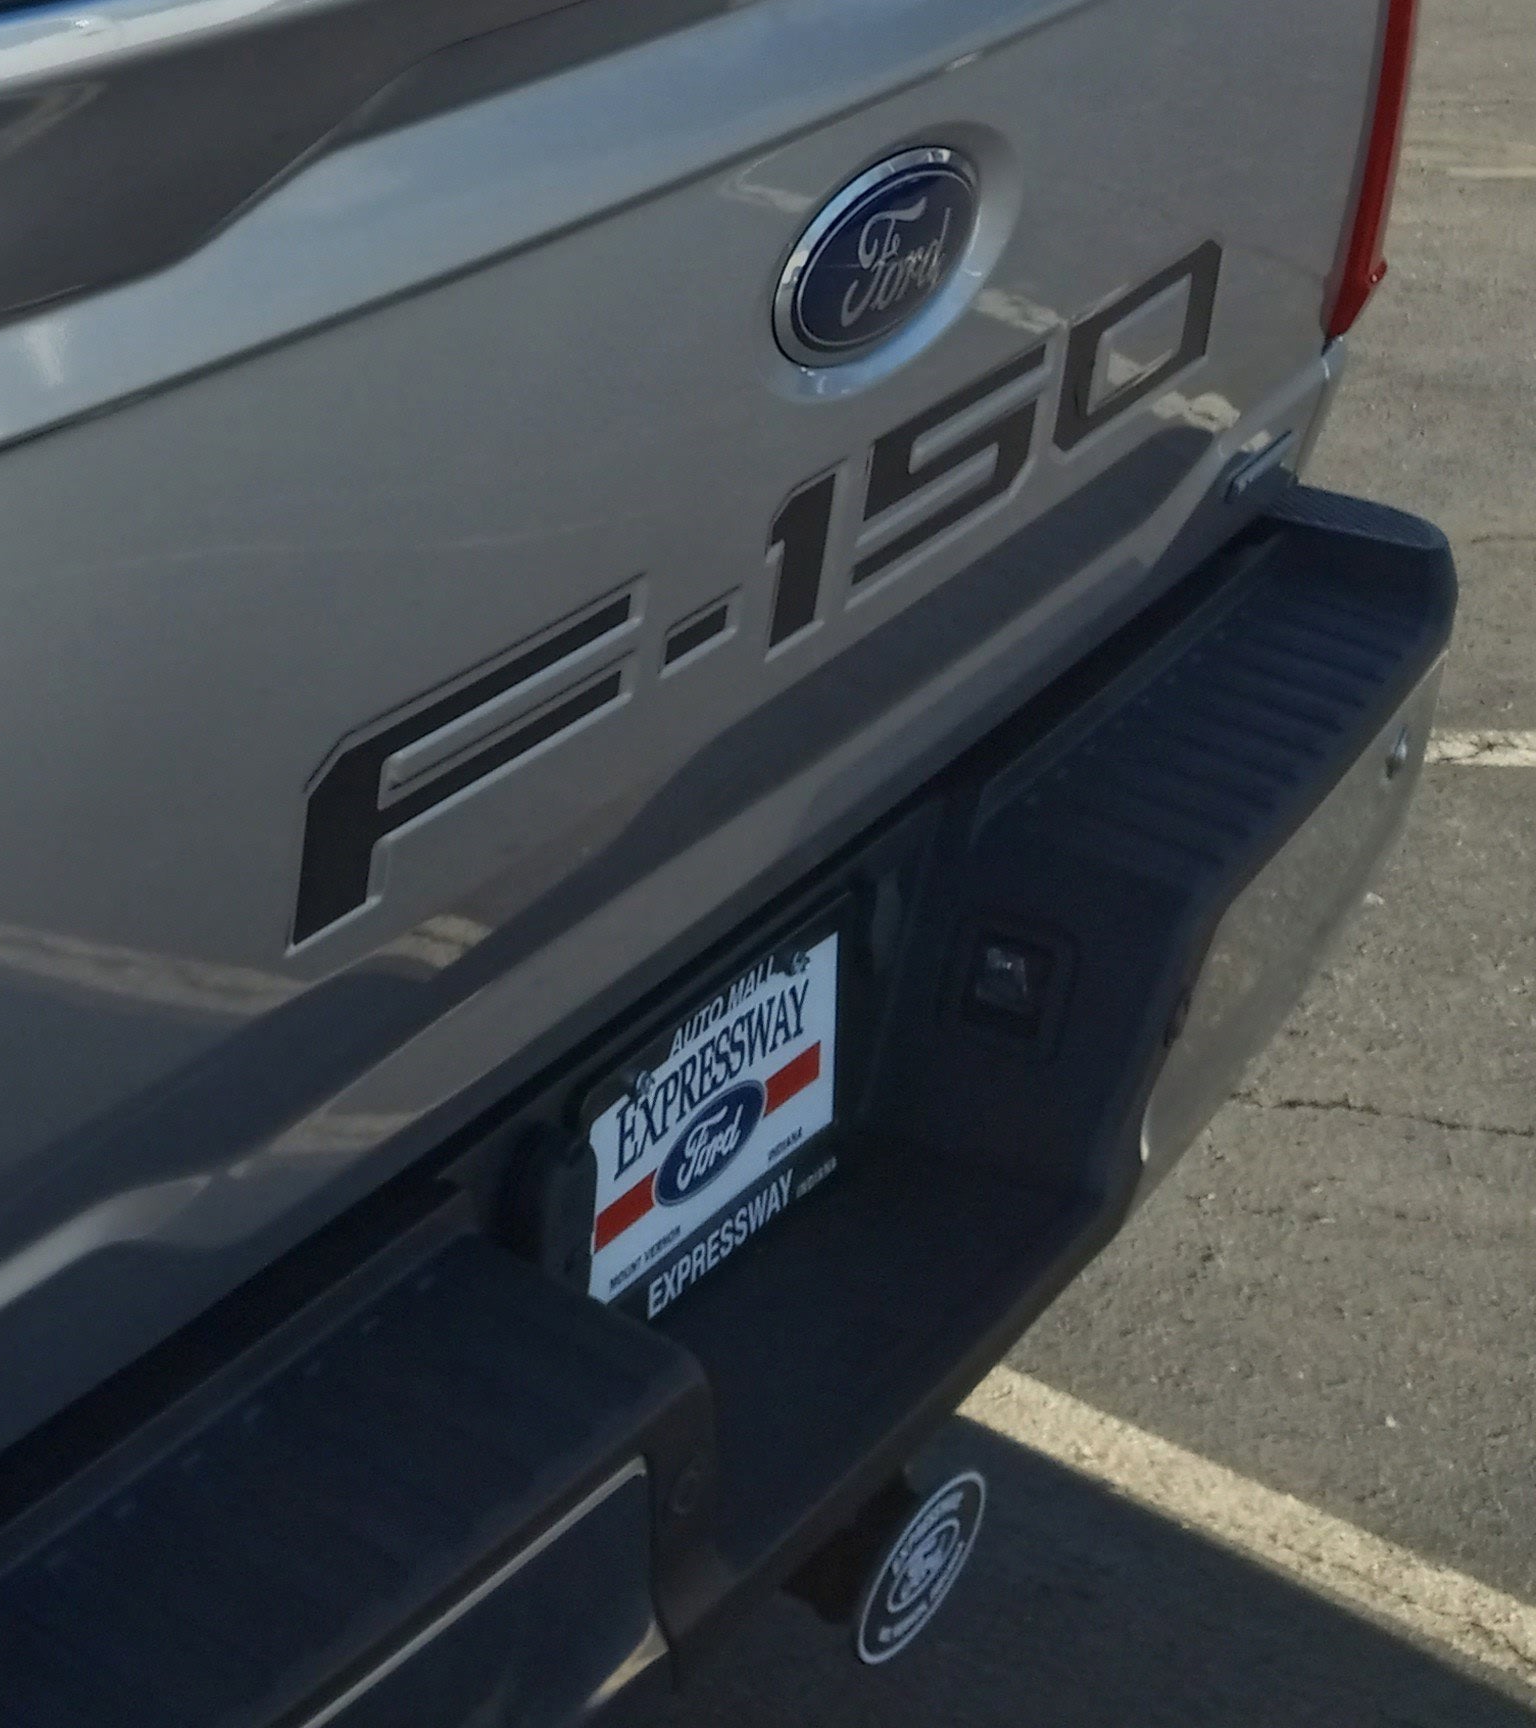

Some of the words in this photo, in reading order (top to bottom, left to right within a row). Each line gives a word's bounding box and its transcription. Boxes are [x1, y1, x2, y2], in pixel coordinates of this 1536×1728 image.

[840, 196, 951, 328] Ford
[288, 240, 1222, 954] F-150
[669, 995, 725, 1058] AUTO
[728, 954, 775, 1010] MALL
[614, 978, 809, 1182] EXPRESSWAY
[677, 1104, 744, 1192] Ford
[646, 1168, 794, 1321] EXPRESSWAY
